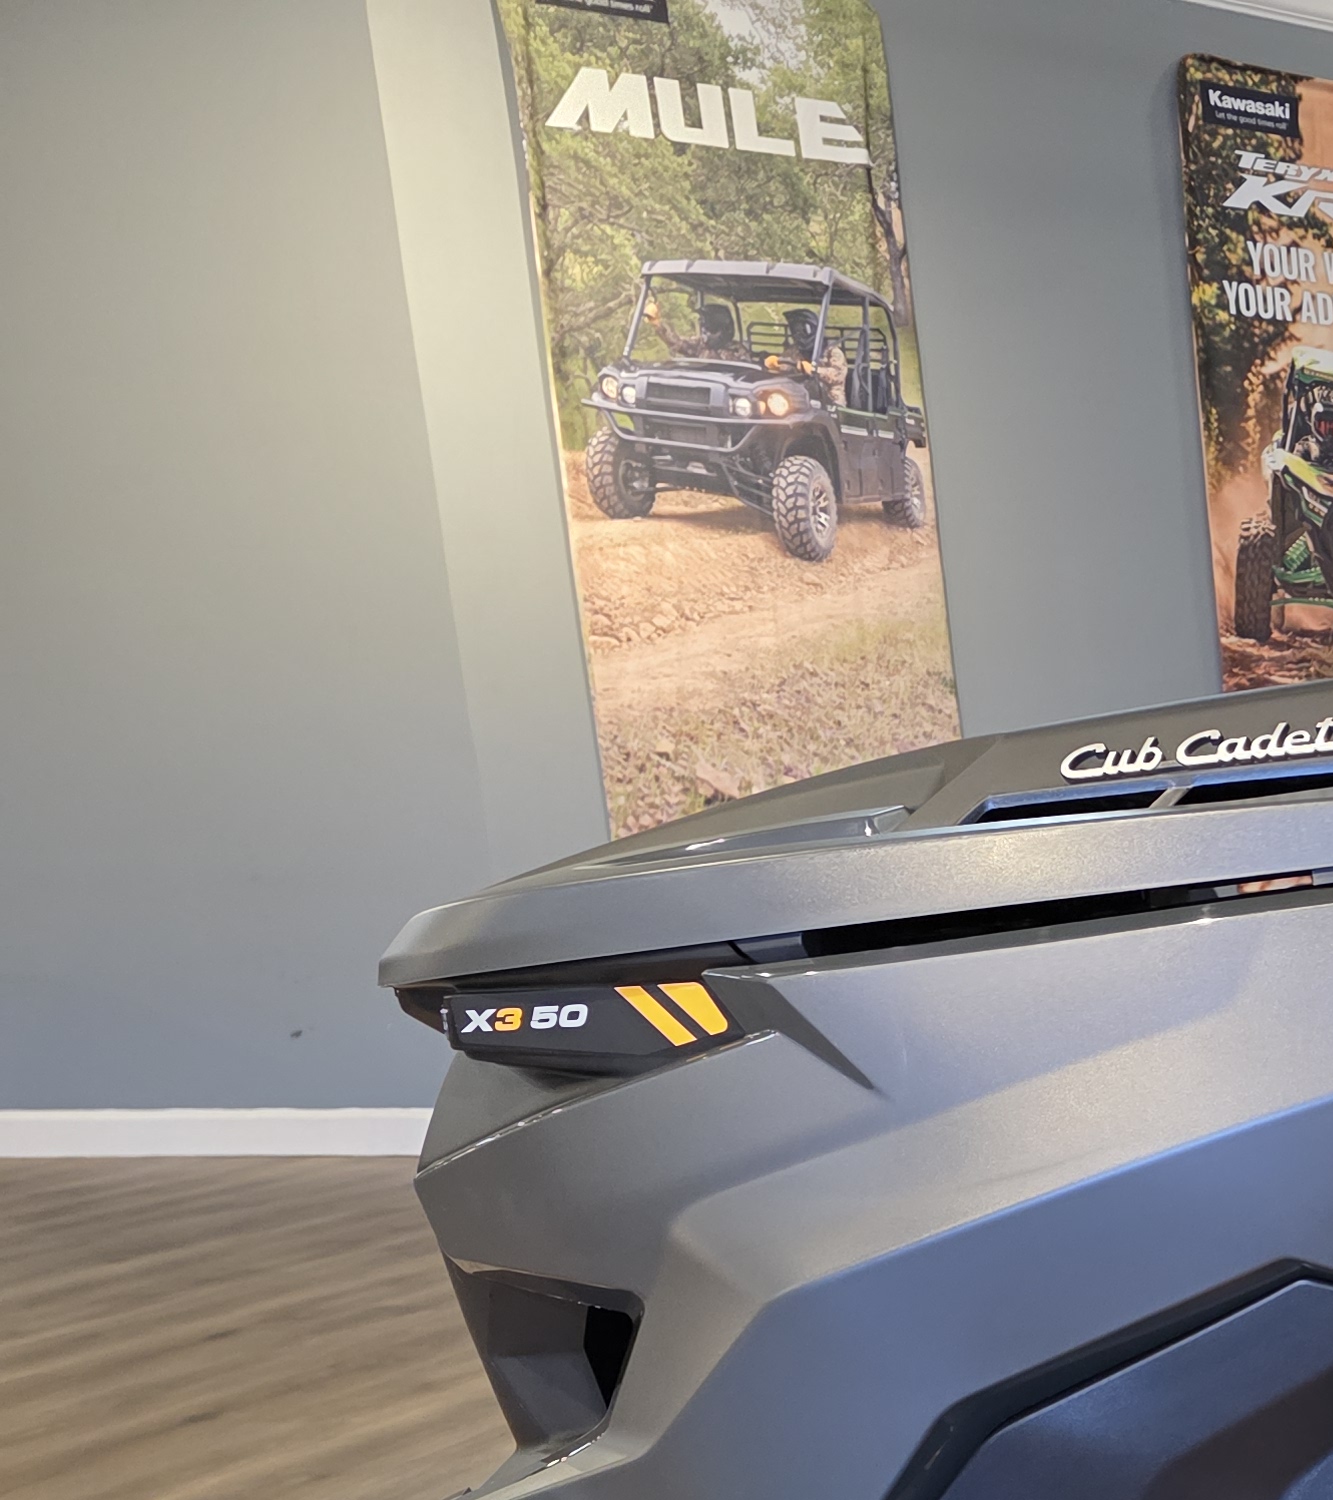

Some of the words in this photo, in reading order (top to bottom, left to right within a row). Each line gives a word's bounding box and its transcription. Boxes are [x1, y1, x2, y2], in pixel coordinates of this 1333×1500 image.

[545, 67, 873, 165] MULE
[1208, 89, 1290, 119] Kawasaki
[1246, 240, 1317, 283] YOUR
[1221, 280, 1293, 322] YOUR
[1060, 736, 1163, 780] Cub
